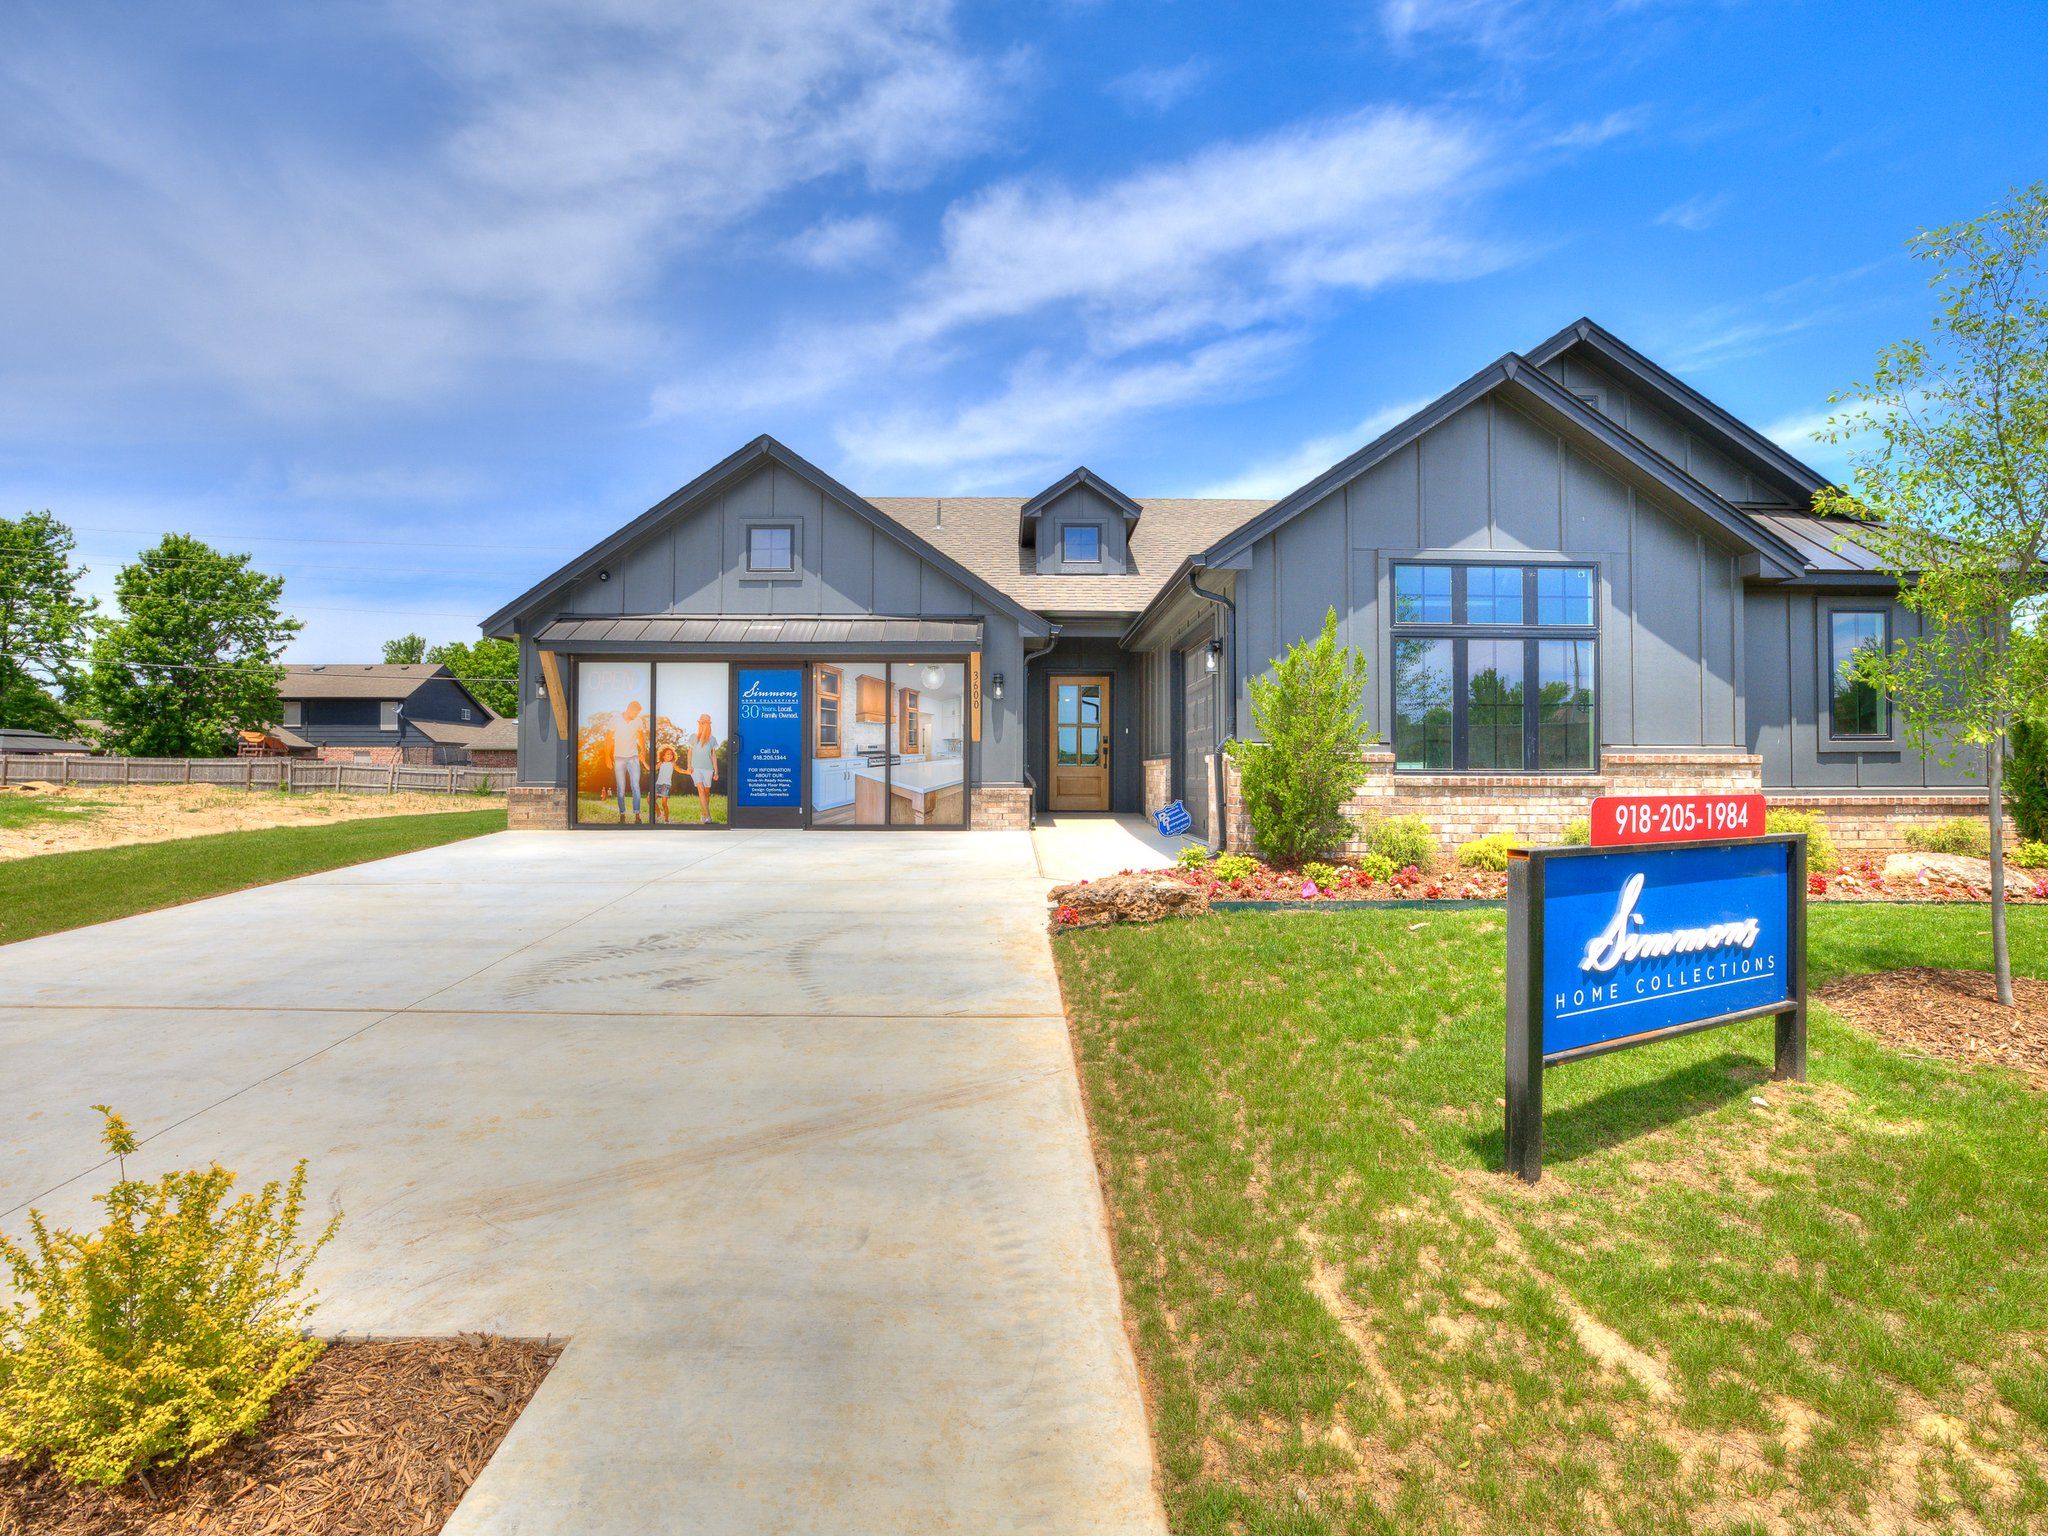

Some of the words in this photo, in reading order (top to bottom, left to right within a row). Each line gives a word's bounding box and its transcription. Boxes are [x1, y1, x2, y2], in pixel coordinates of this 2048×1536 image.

[742, 680, 798, 698] Simmons
[741, 704, 759, 719] 30
[1615, 802, 1749, 835] 918-205-1984
[1577, 872, 1760, 972] Simmons
[1555, 984, 1618, 1010] HOME
[1636, 954, 1776, 994] COLLECTIONS
